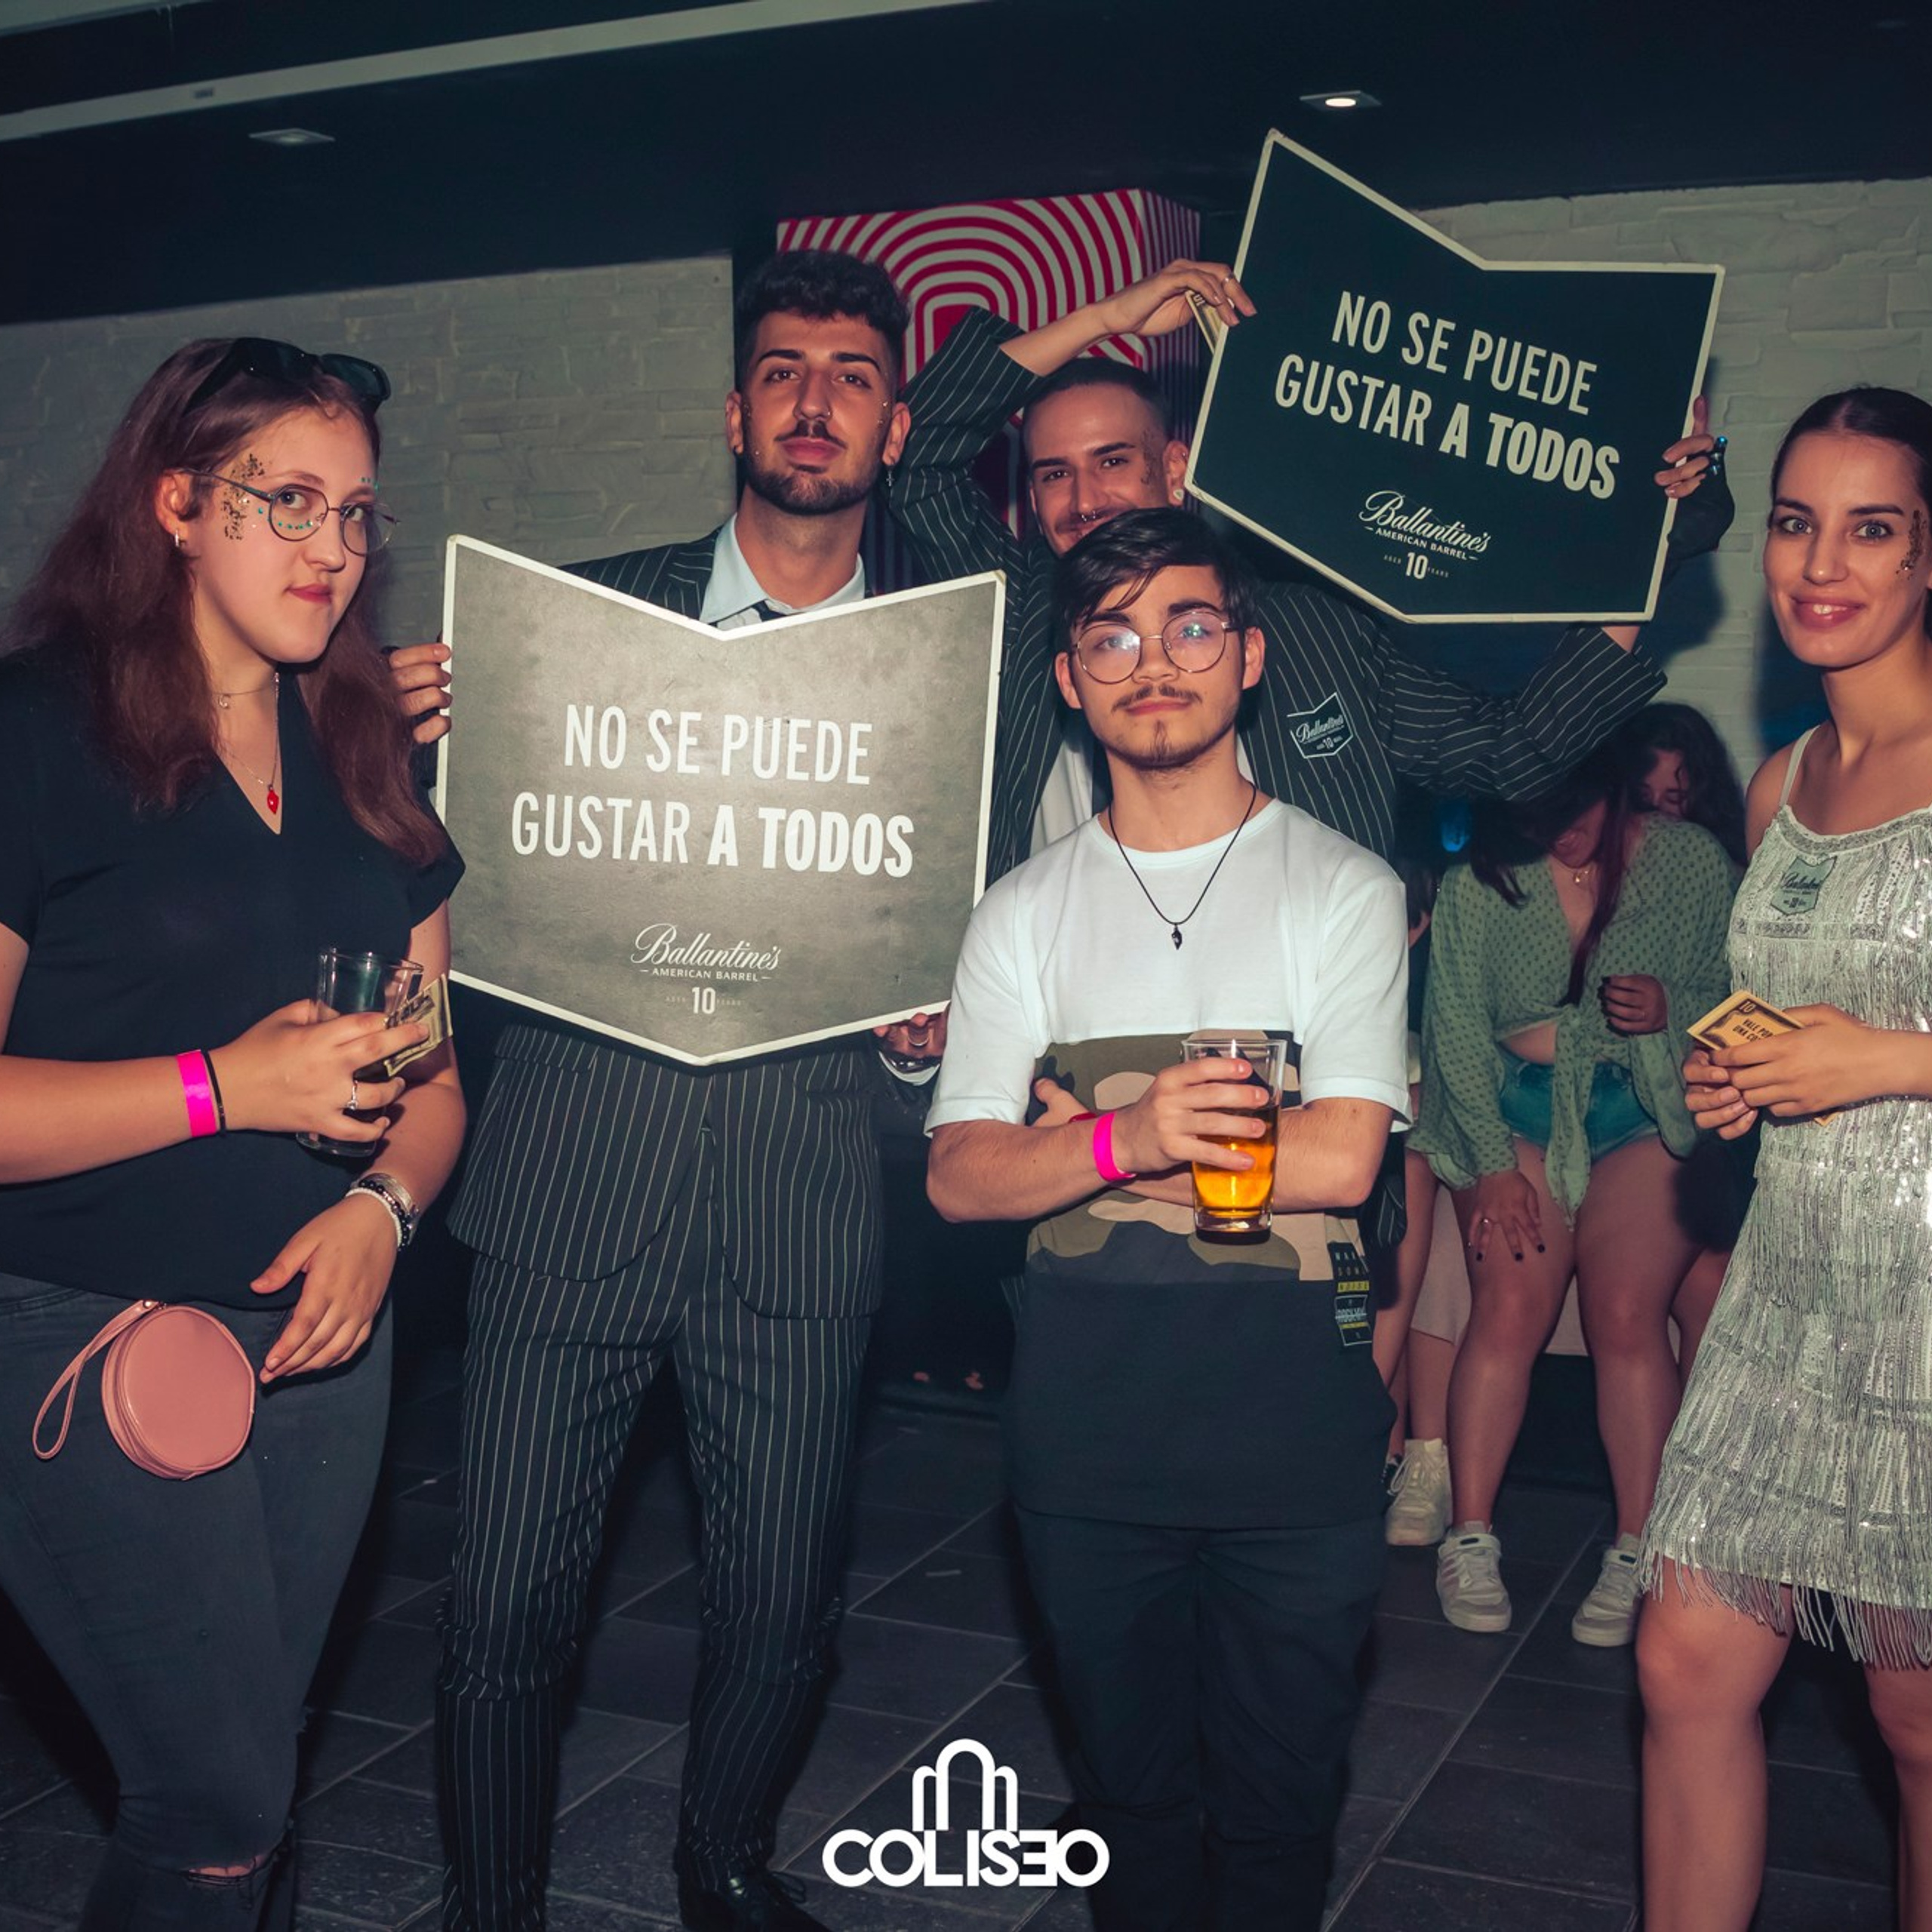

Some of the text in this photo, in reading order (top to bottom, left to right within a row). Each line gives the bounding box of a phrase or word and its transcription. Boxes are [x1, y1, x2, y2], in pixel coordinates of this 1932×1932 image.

[1332, 291, 1597, 415] NO SE PUEDE
[1275, 354, 1620, 500] GUSTAR A TODOS
[1358, 491, 1491, 552] Ballantine's
[1375, 528, 1467, 560] AMERICAN BARREL
[1405, 552, 1429, 580] 10
[565, 705, 872, 785] NO SE PUEDE
[512, 792, 915, 878] GUSTAR A TODOS
[630, 923, 781, 971] Ballantine's
[652, 968, 758, 982] AMERICAN BARREL
[691, 986, 716, 1014] 10
[1739, 1001, 1756, 1013] 10
[1746, 1033, 1761, 1041] CO
